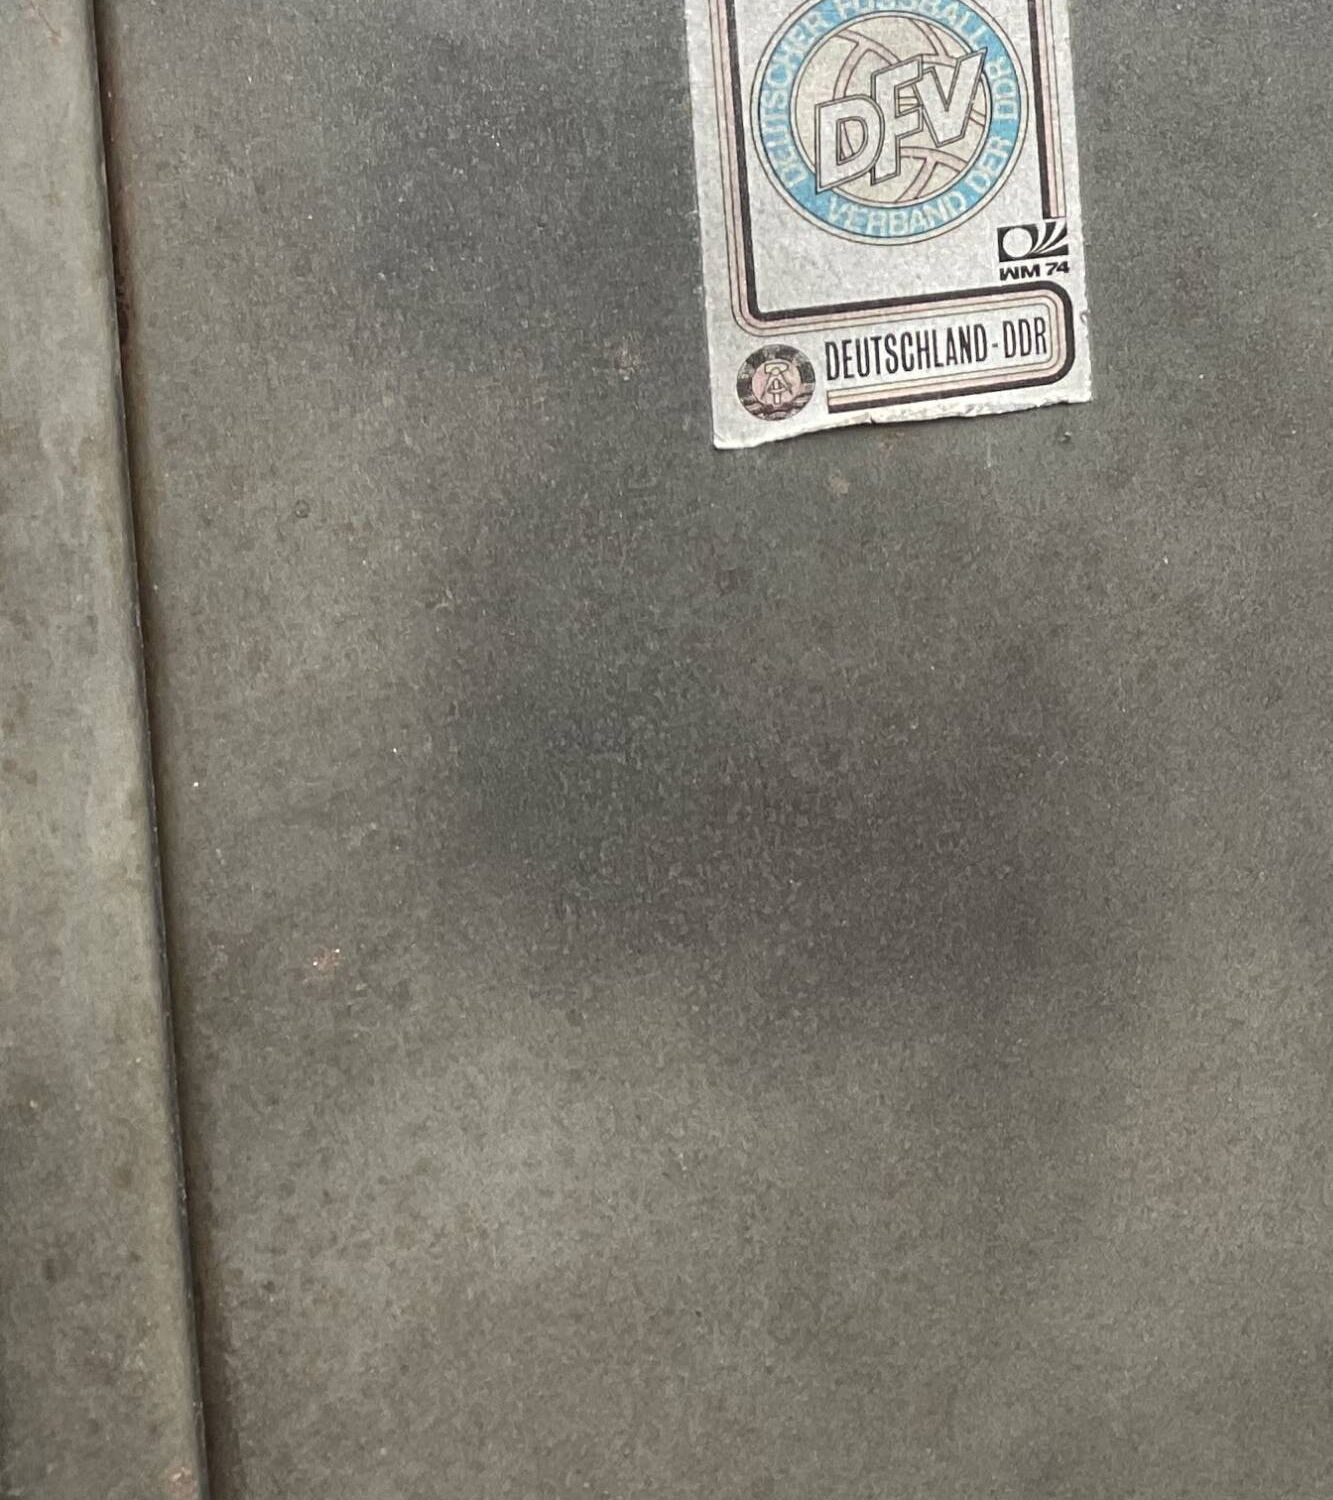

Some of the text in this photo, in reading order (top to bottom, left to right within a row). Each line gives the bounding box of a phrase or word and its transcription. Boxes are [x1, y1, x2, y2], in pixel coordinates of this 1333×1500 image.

[814, 46, 988, 194] DFV
[999, 260, 1070, 281] WM 74
[824, 323, 989, 381] DEUTSCHLAND
[1001, 316, 1048, 359] DDR
